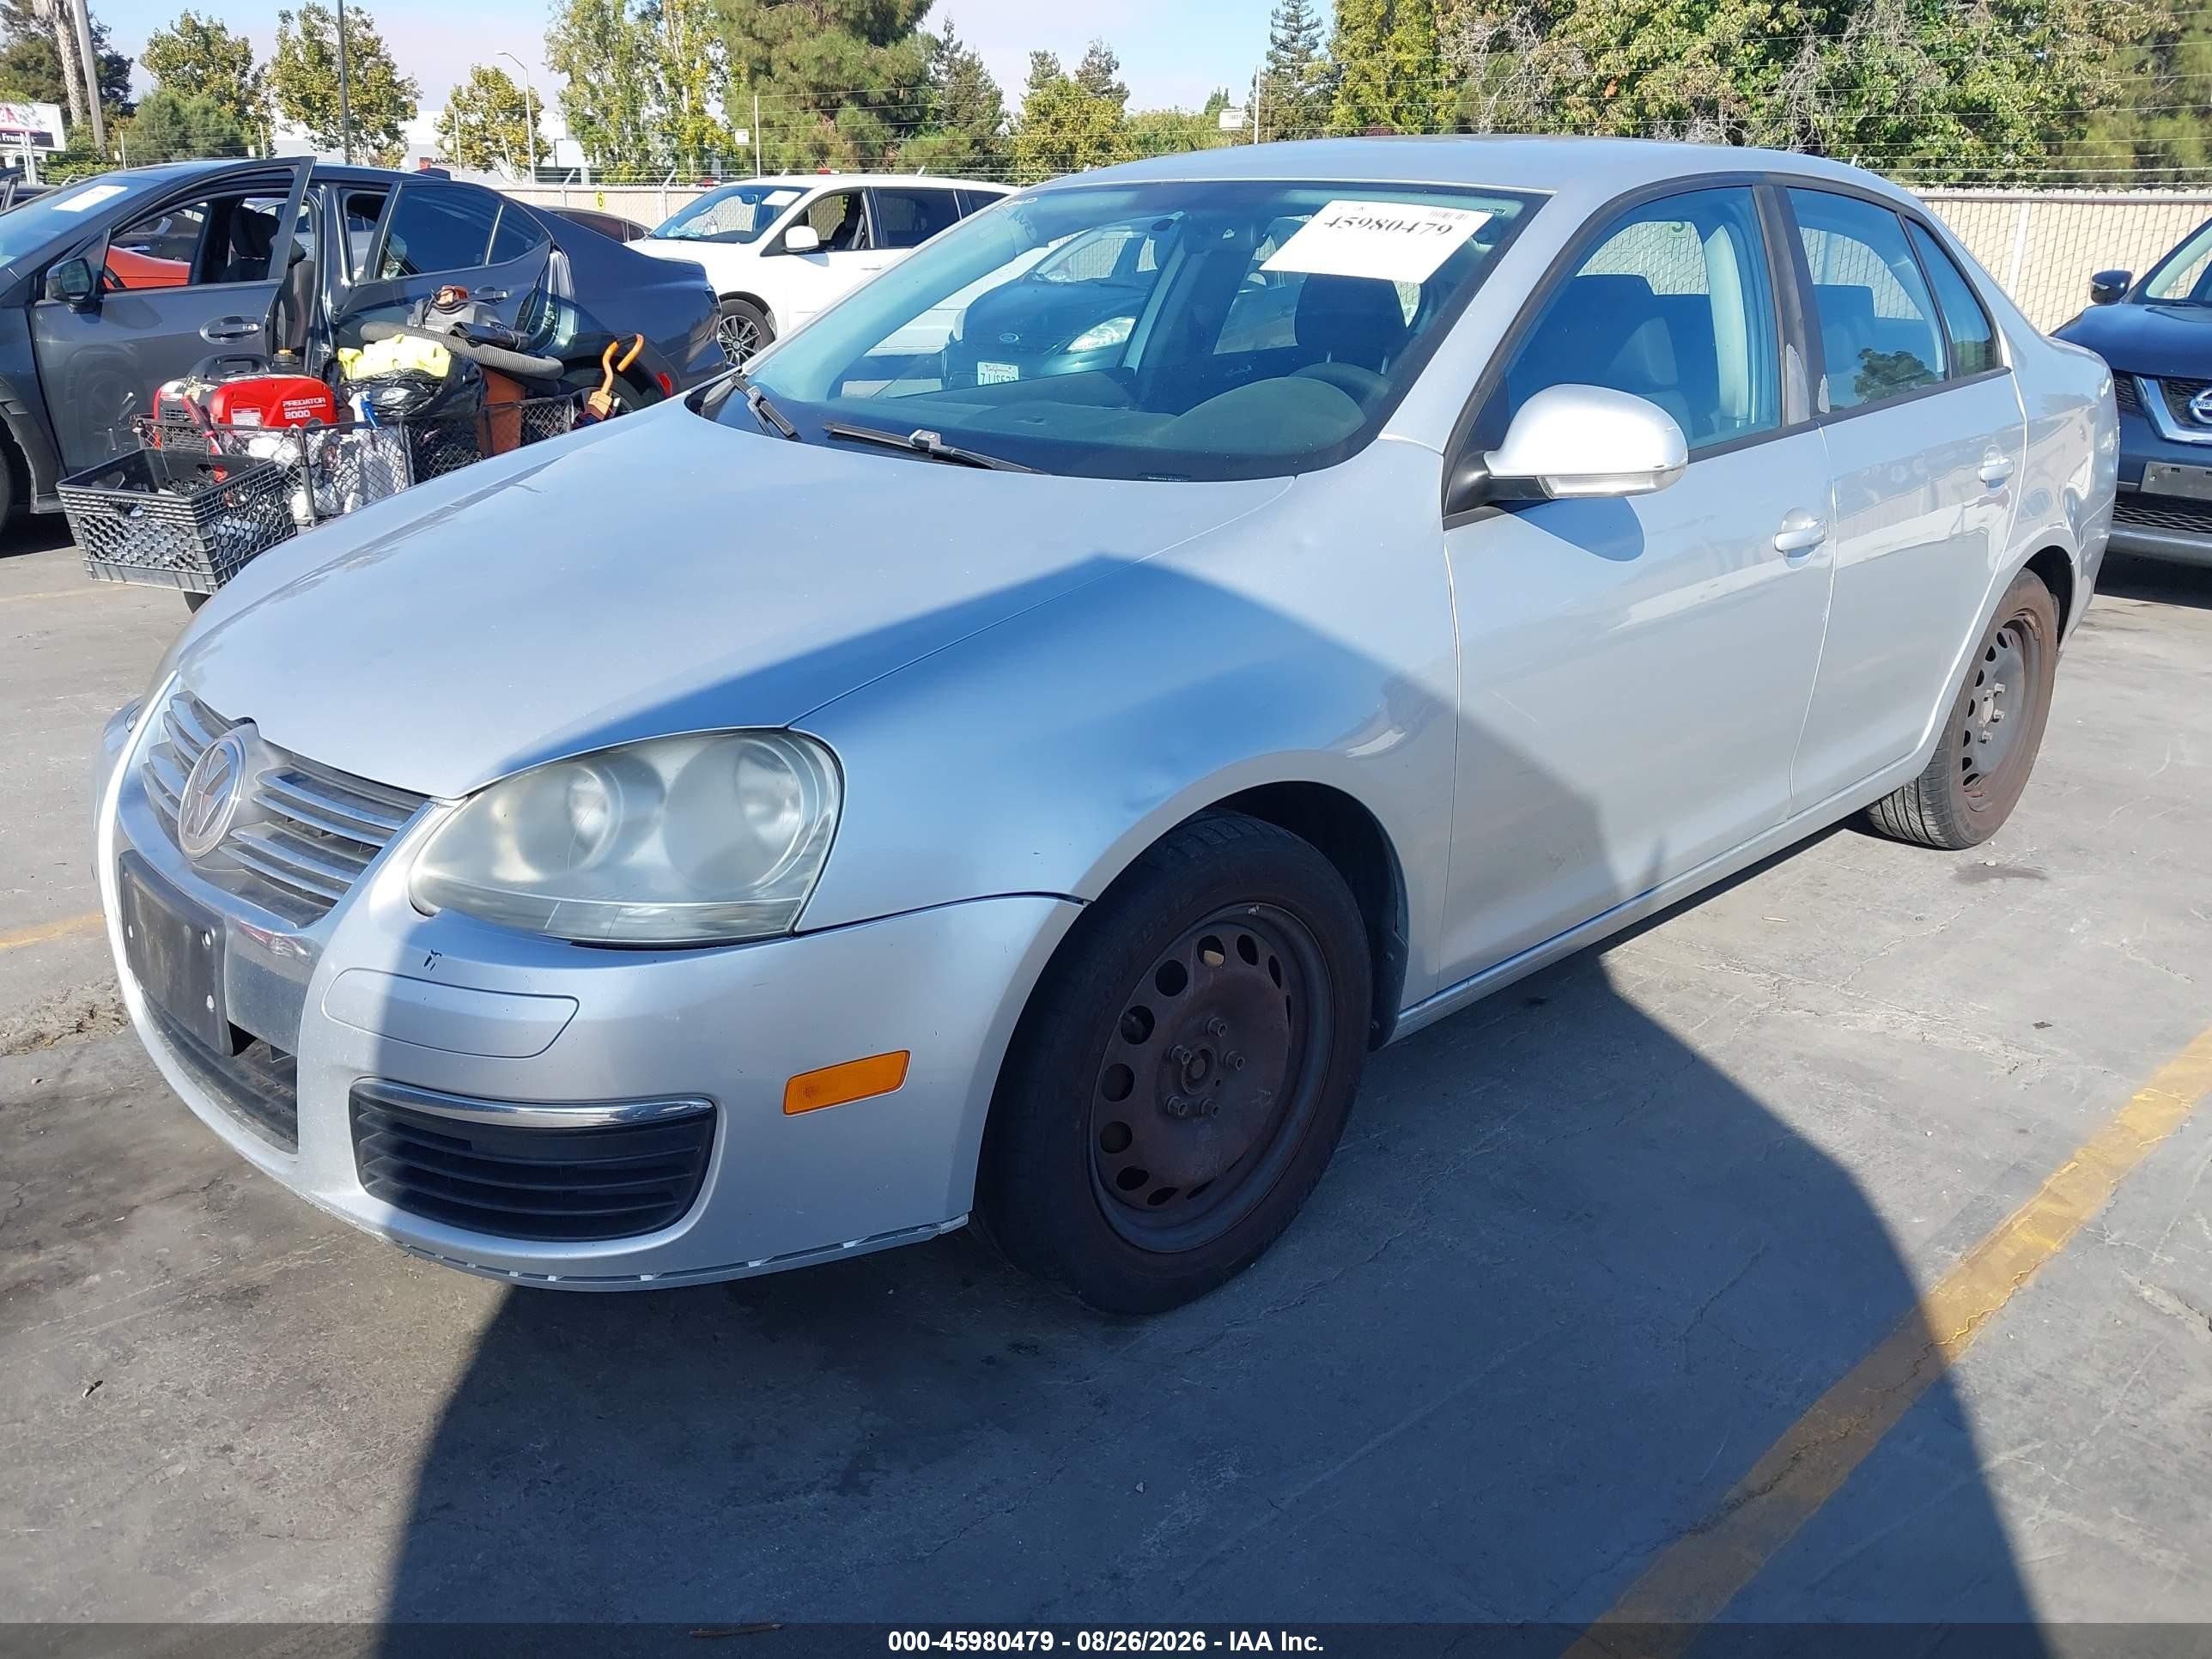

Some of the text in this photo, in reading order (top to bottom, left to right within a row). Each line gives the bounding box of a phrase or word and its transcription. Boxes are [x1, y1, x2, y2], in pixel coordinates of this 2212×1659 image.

[598, 191, 604, 207] 6
[1323, 216, 1453, 236] 45980479
[283, 397, 325, 407] PREDATOR
[2194, 399, 2212, 408] NIS
[284, 410, 311, 420] 2000
